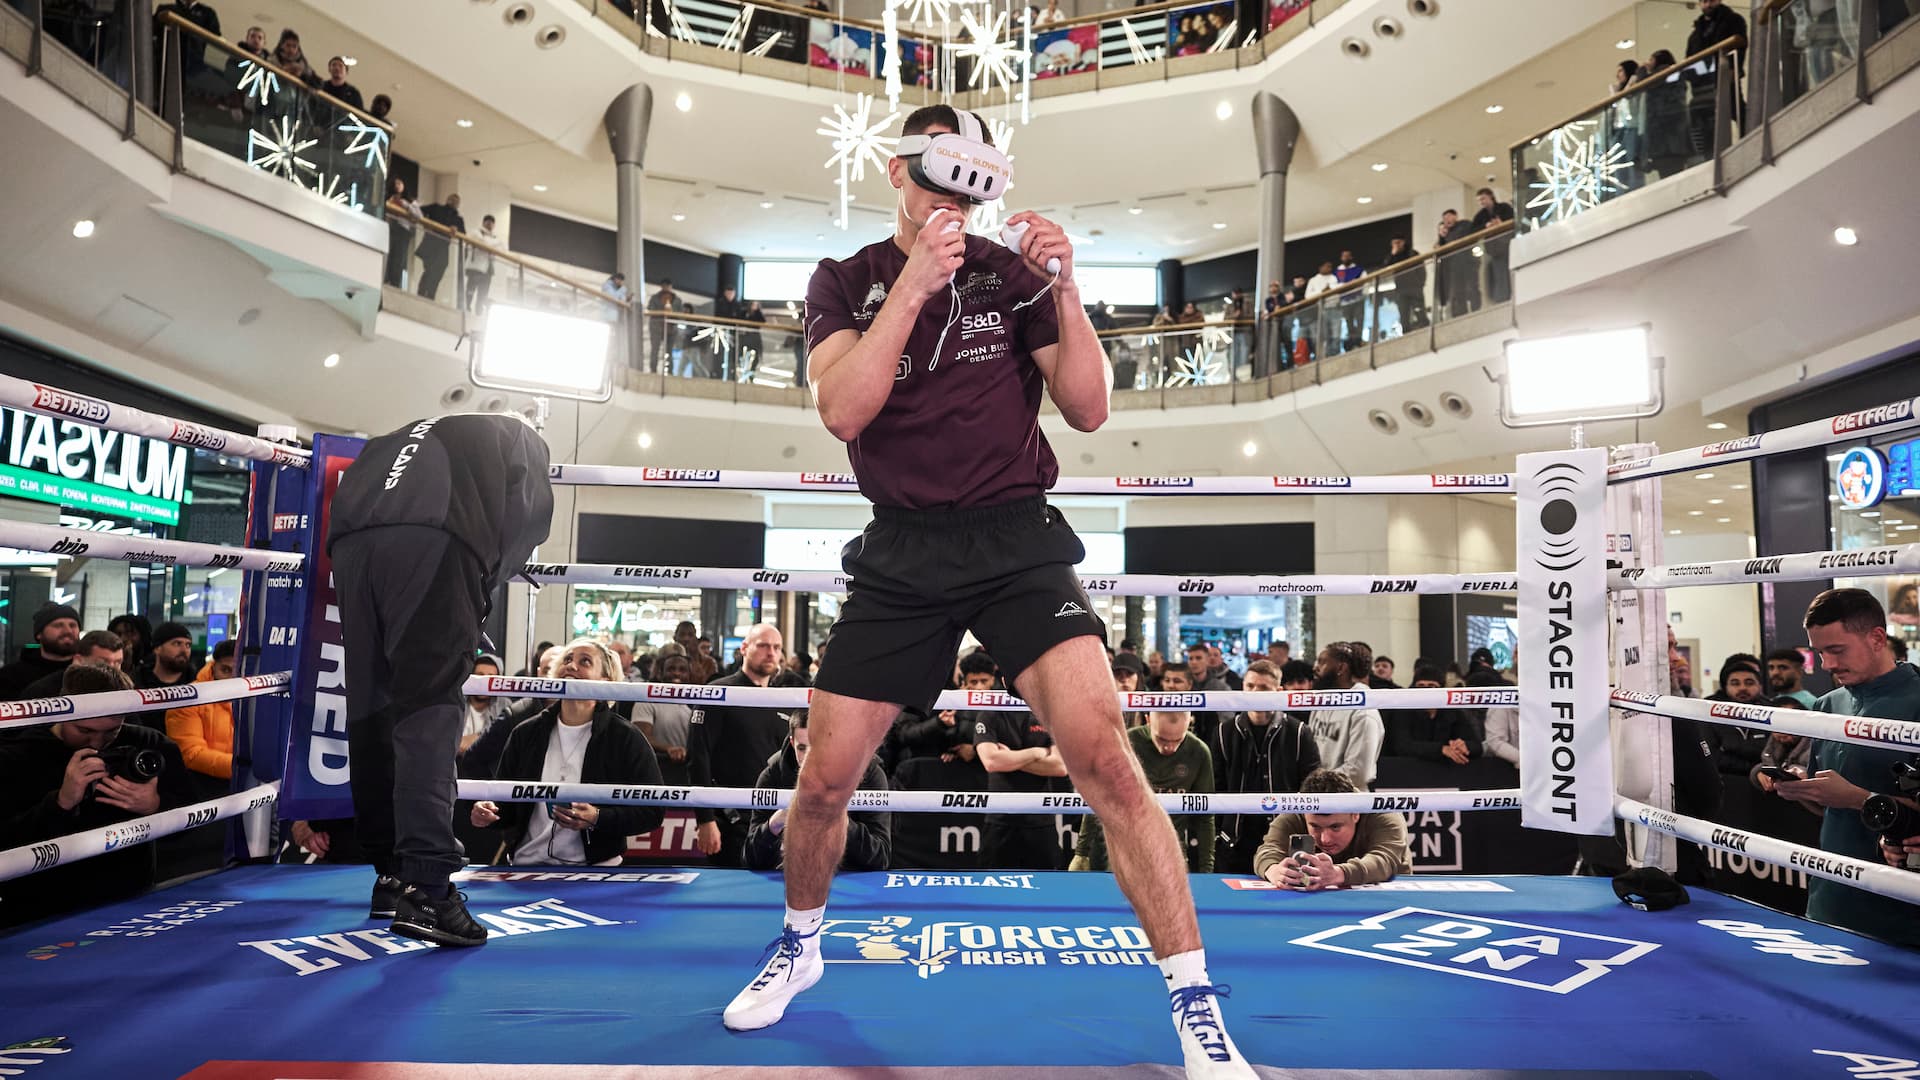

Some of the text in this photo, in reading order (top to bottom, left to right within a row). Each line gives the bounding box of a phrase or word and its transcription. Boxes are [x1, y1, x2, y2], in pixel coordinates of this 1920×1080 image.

[936, 147, 969, 162] GOLD
[962, 311, 1001, 329] S&D
[955, 346, 987, 361] JOHN
[39, 388, 109, 421] BETFRED
[174, 424, 225, 450] BETFRED
[1704, 433, 1761, 456] BETFRED
[1835, 402, 1910, 432] BETFRED
[0, 405, 193, 505] TASYLUM.
[646, 467, 717, 481] BETFRED
[1118, 474, 1508, 487] BETFRED BETFRED BETFRED
[51, 537, 89, 560] drip
[205, 553, 244, 568] DAZN
[1744, 558, 1784, 575] DAZN
[1819, 550, 1898, 568] EVERLAST
[613, 567, 692, 579] EVERLAST
[753, 570, 789, 585] drip
[1178, 579, 1215, 594] drip
[1258, 582, 1326, 593] matchroom.
[1370, 580, 1418, 593] DAZN
[1461, 581, 1518, 592] EVERLA
[490, 678, 566, 693] BETFRED
[650, 685, 726, 701] BETFRED
[1131, 690, 1519, 706] BETFRED BETFRED BETFRED
[0, 697, 72, 717] BETFRED
[145, 685, 196, 702] BETFRED
[1548, 581, 1577, 822] STAGE FRONT
[1712, 703, 1771, 722] BETFRED
[1846, 719, 1920, 746] BETFRED
[511, 785, 559, 799] DAZN
[612, 789, 691, 801] EVERLAST
[941, 794, 989, 808] DAZN
[1281, 796, 1320, 804] RIYADH
[1281, 804, 1320, 812] SEASON
[1372, 797, 1419, 810] DAZN
[184, 806, 219, 829] DAZN
[1652, 810, 1679, 824] RIYADH
[120, 822, 151, 836] RIYADH
[1711, 828, 1865, 881] DAZN EVERLAST
[470, 871, 684, 884] ETFRED
[884, 874, 1034, 889] EVERLAST
[86, 900, 211, 937] RIYADH
[126, 900, 244, 937] SEASON
[238, 898, 624, 977] EVEAST
[919, 921, 1153, 955] FORGED
[961, 951, 1160, 966] IRISH STOUT
